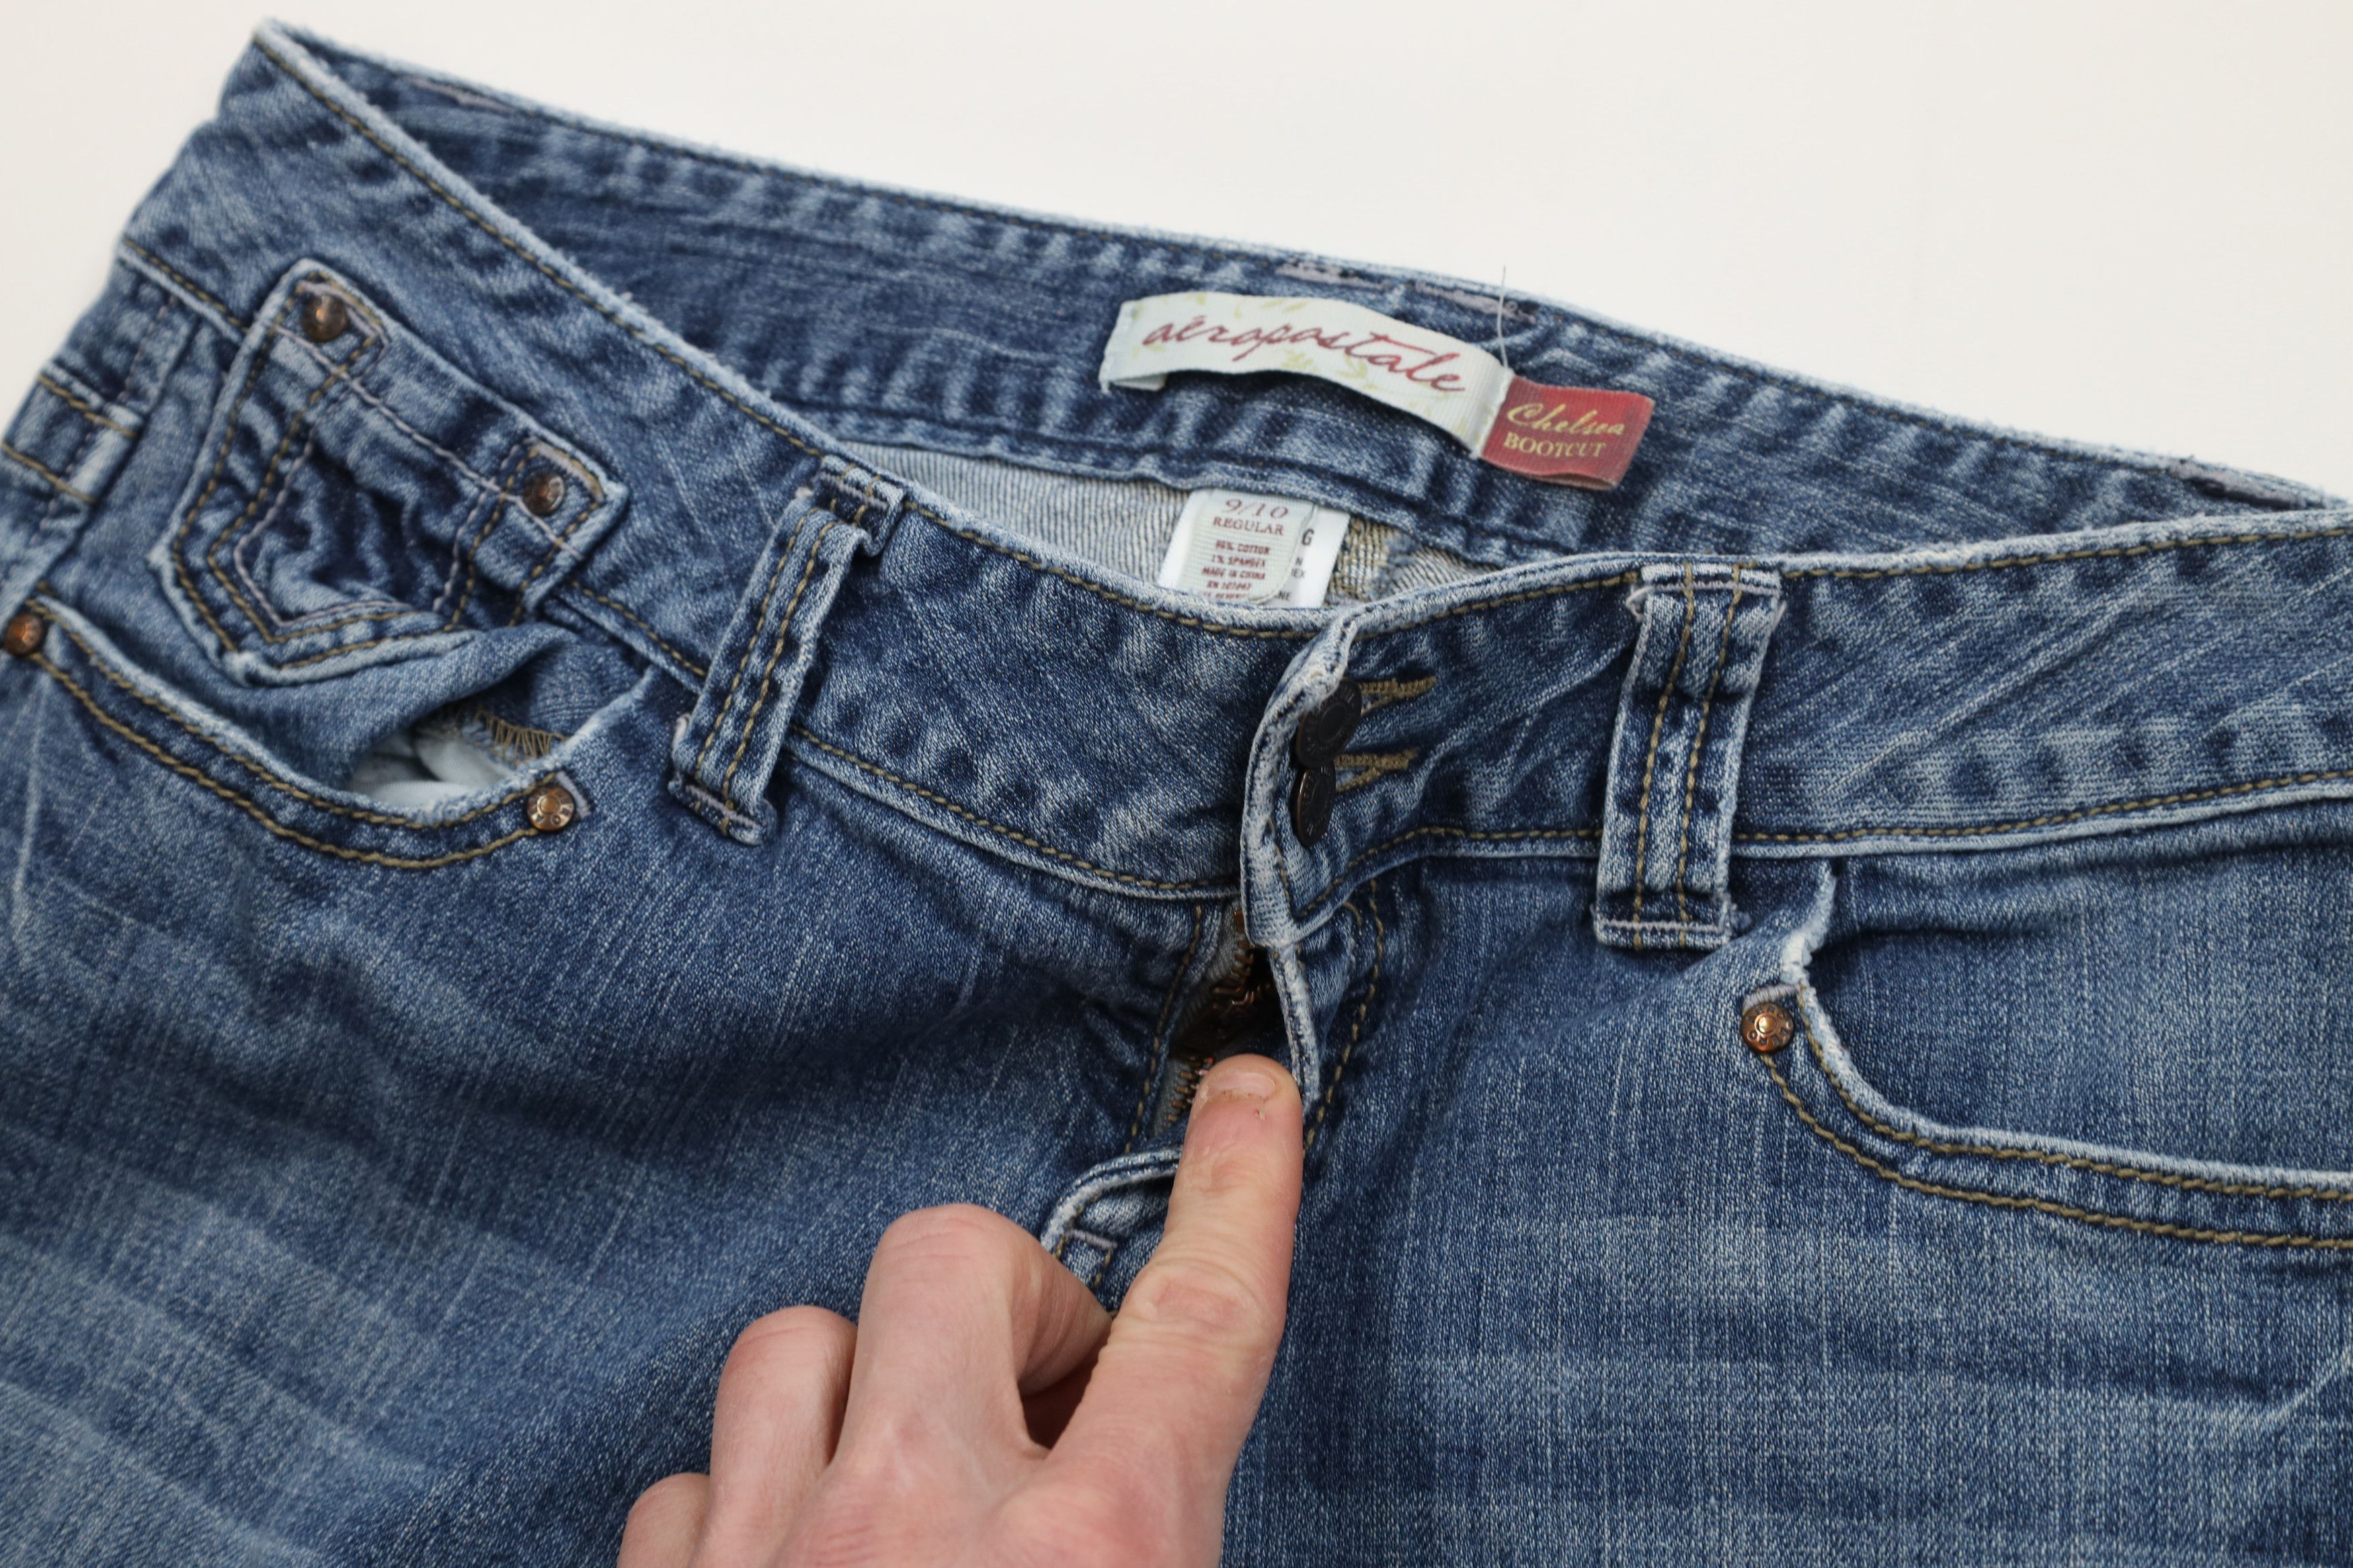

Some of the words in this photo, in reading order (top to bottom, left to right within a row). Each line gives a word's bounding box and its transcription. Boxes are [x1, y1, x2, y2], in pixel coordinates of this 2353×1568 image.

[1507, 403, 1625, 436] Chelsea
[1503, 431, 1606, 458] BOOTCUT
[1221, 498, 1288, 520] 9/10
[1213, 516, 1285, 536] REGULAR
[1237, 542, 1270, 554] COTTON
[1228, 556, 1266, 568] SPANDEX
[1202, 566, 1226, 577] MADE
[1228, 569, 1237, 577] IN
[1239, 569, 1265, 580] CHINA
